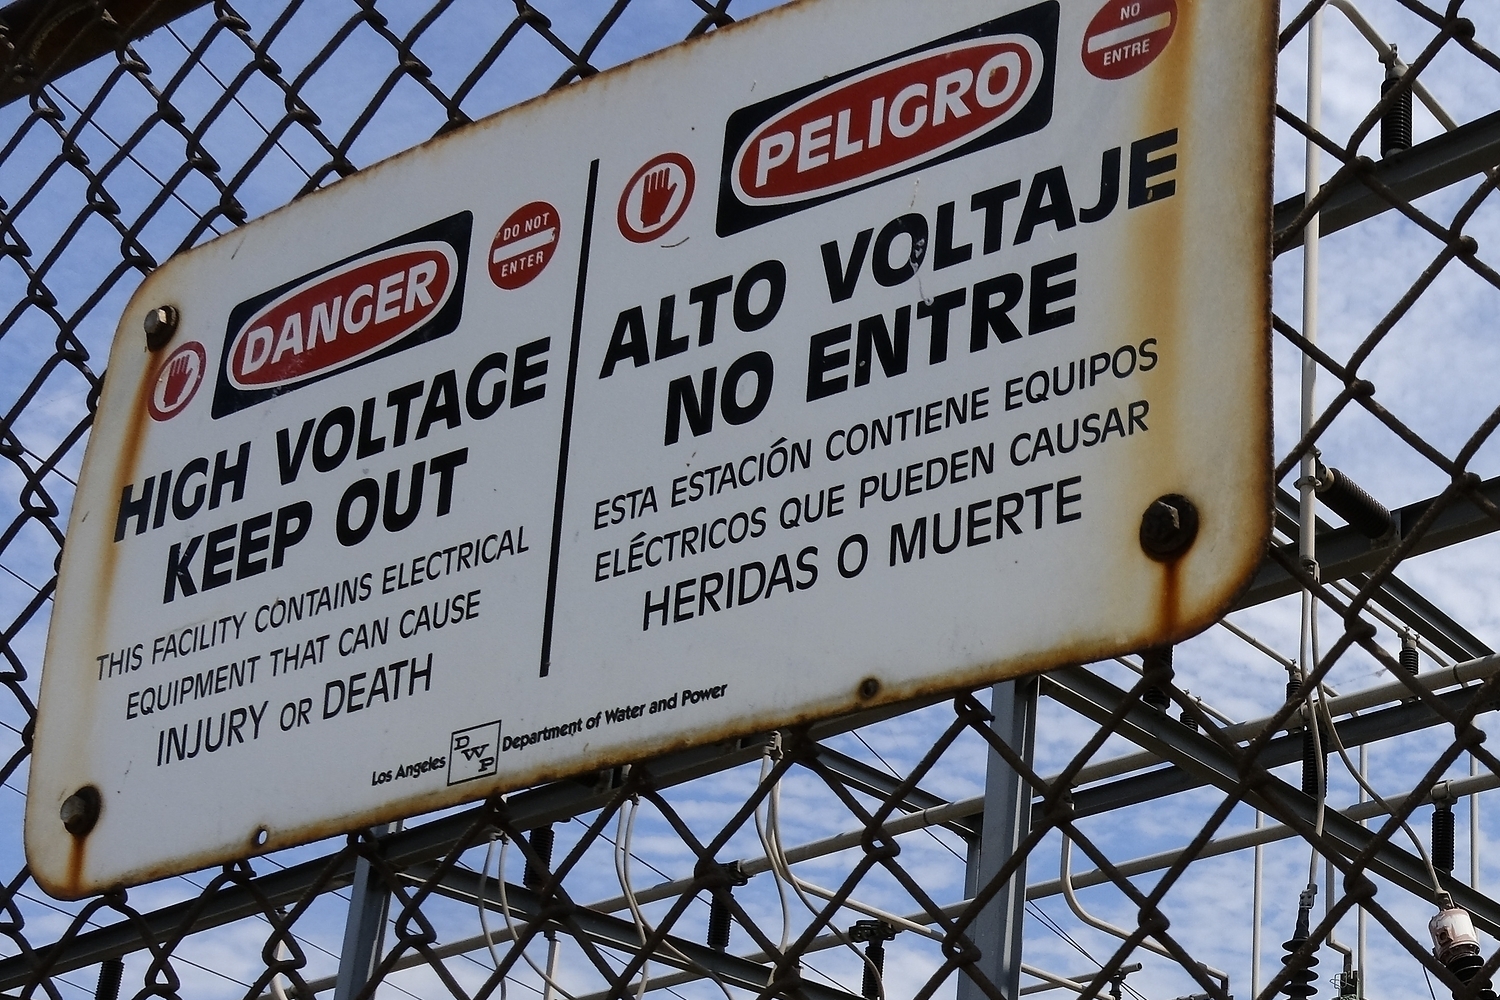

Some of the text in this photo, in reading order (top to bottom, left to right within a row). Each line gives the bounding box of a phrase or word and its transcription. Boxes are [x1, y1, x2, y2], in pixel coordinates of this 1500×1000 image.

[1102, 38, 1150, 65] ENTRE
[1120, 3, 1140, 20] NO
[754, 50, 1022, 188] PELIGRO
[501, 250, 544, 278] ENTER
[503, 214, 549, 241] DO NOT
[598, 128, 1179, 380] ALTO VOLTAJE
[241, 260, 437, 376] DANGER
[664, 252, 1077, 446] NO ENTRE
[114, 336, 550, 543] HIGH VOLTAGE
[593, 338, 1158, 530] ESTA ESTACIÓN CONTIENE EQUIPOS
[594, 400, 1149, 583] ELÉCTRICOS QUE PUEDEN CAUSAR
[163, 447, 469, 604] KEEP OUT
[642, 476, 1082, 631] HERIDAS O MUERTE
[96, 525, 529, 680] THIS FACILITY CONTAINS ELECTRICAL
[126, 589, 481, 720] EQUIPMENT THAT CAN CAUSE
[156, 653, 433, 766] INJURY OR DEATH
[372, 770, 392, 786] Los
[396, 755, 446, 782] Angeles
[502, 718, 582, 752] Department
[586, 711, 601, 730] of
[604, 702, 646, 725] Water
[649, 693, 677, 715] and
[681, 684, 728, 707] Power
